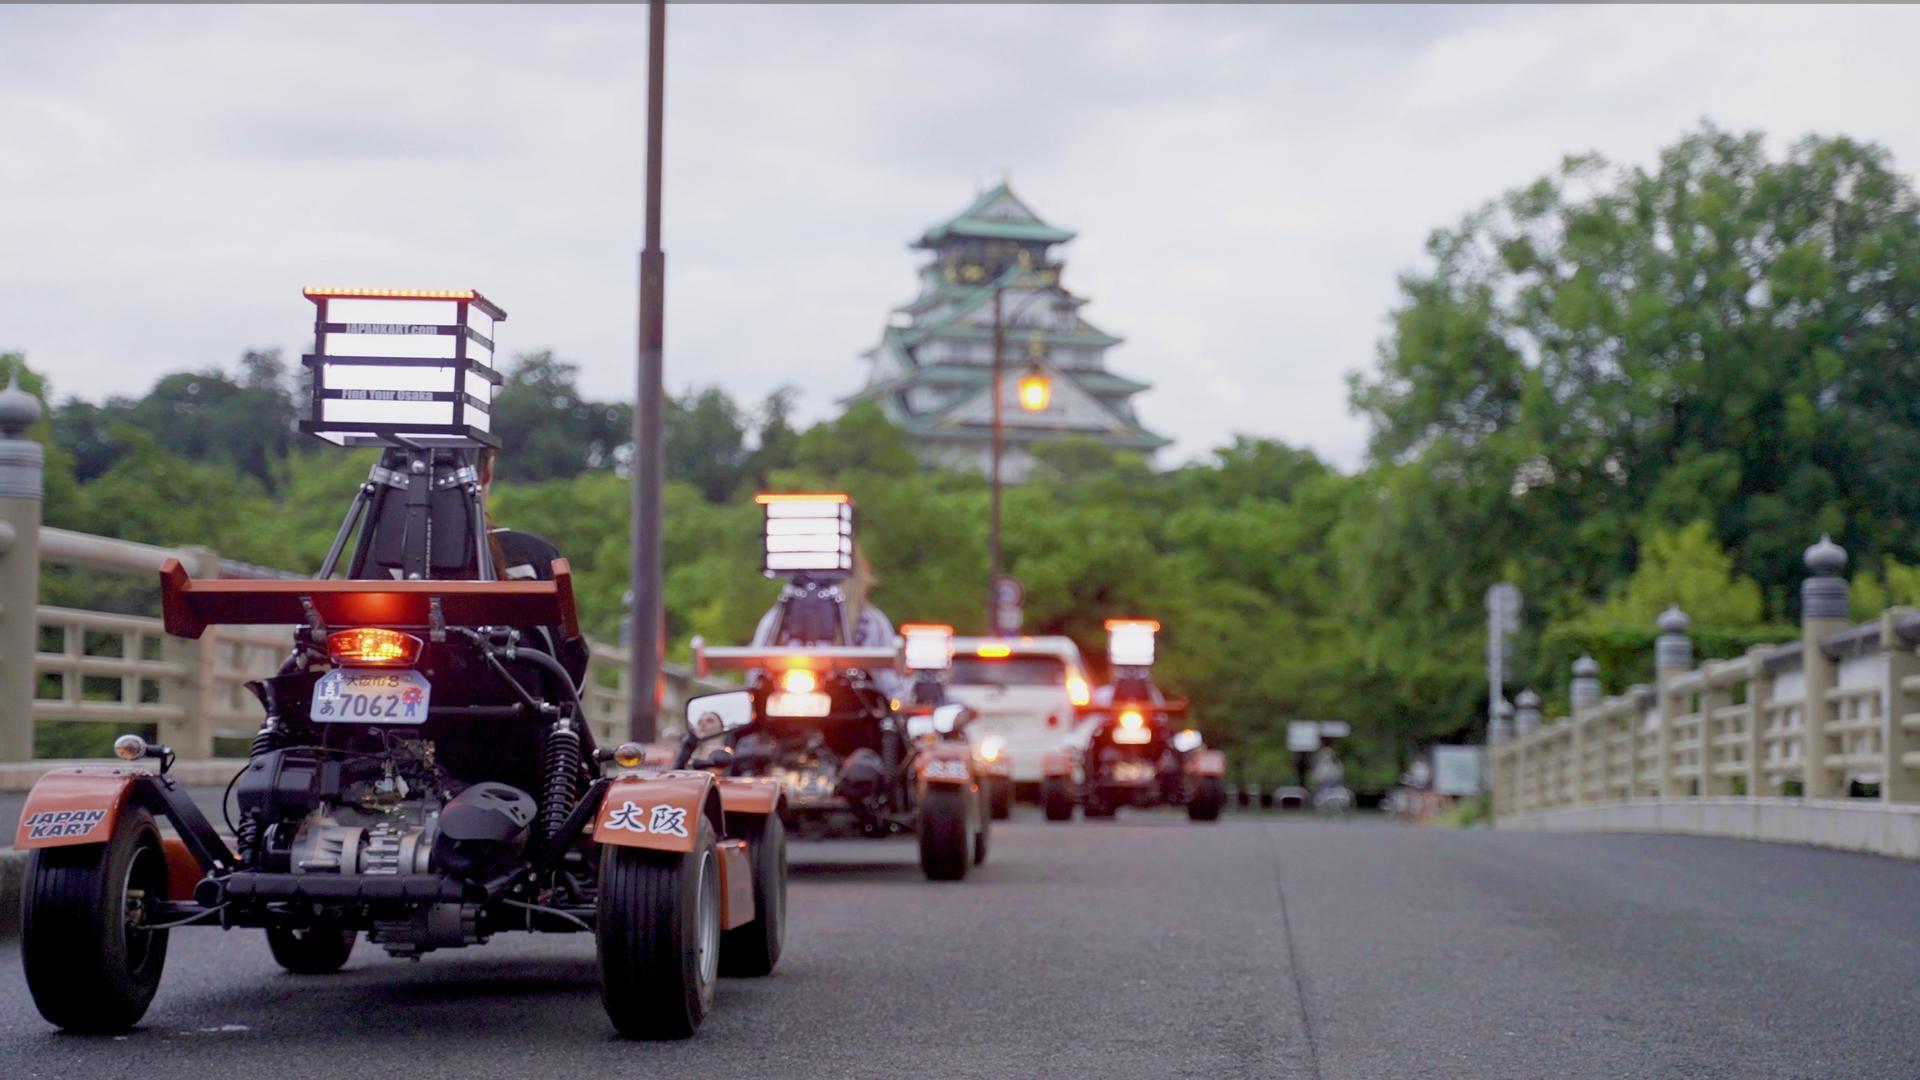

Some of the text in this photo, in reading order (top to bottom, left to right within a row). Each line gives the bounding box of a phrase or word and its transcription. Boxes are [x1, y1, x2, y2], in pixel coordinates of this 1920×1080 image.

[369, 390, 395, 401] Your
[396, 391, 434, 401] Osaka
[320, 694, 399, 717] あ 7062
[26, 810, 106, 825] JAPAN
[606, 802, 687, 836] 大阪
[29, 823, 97, 838] KART
